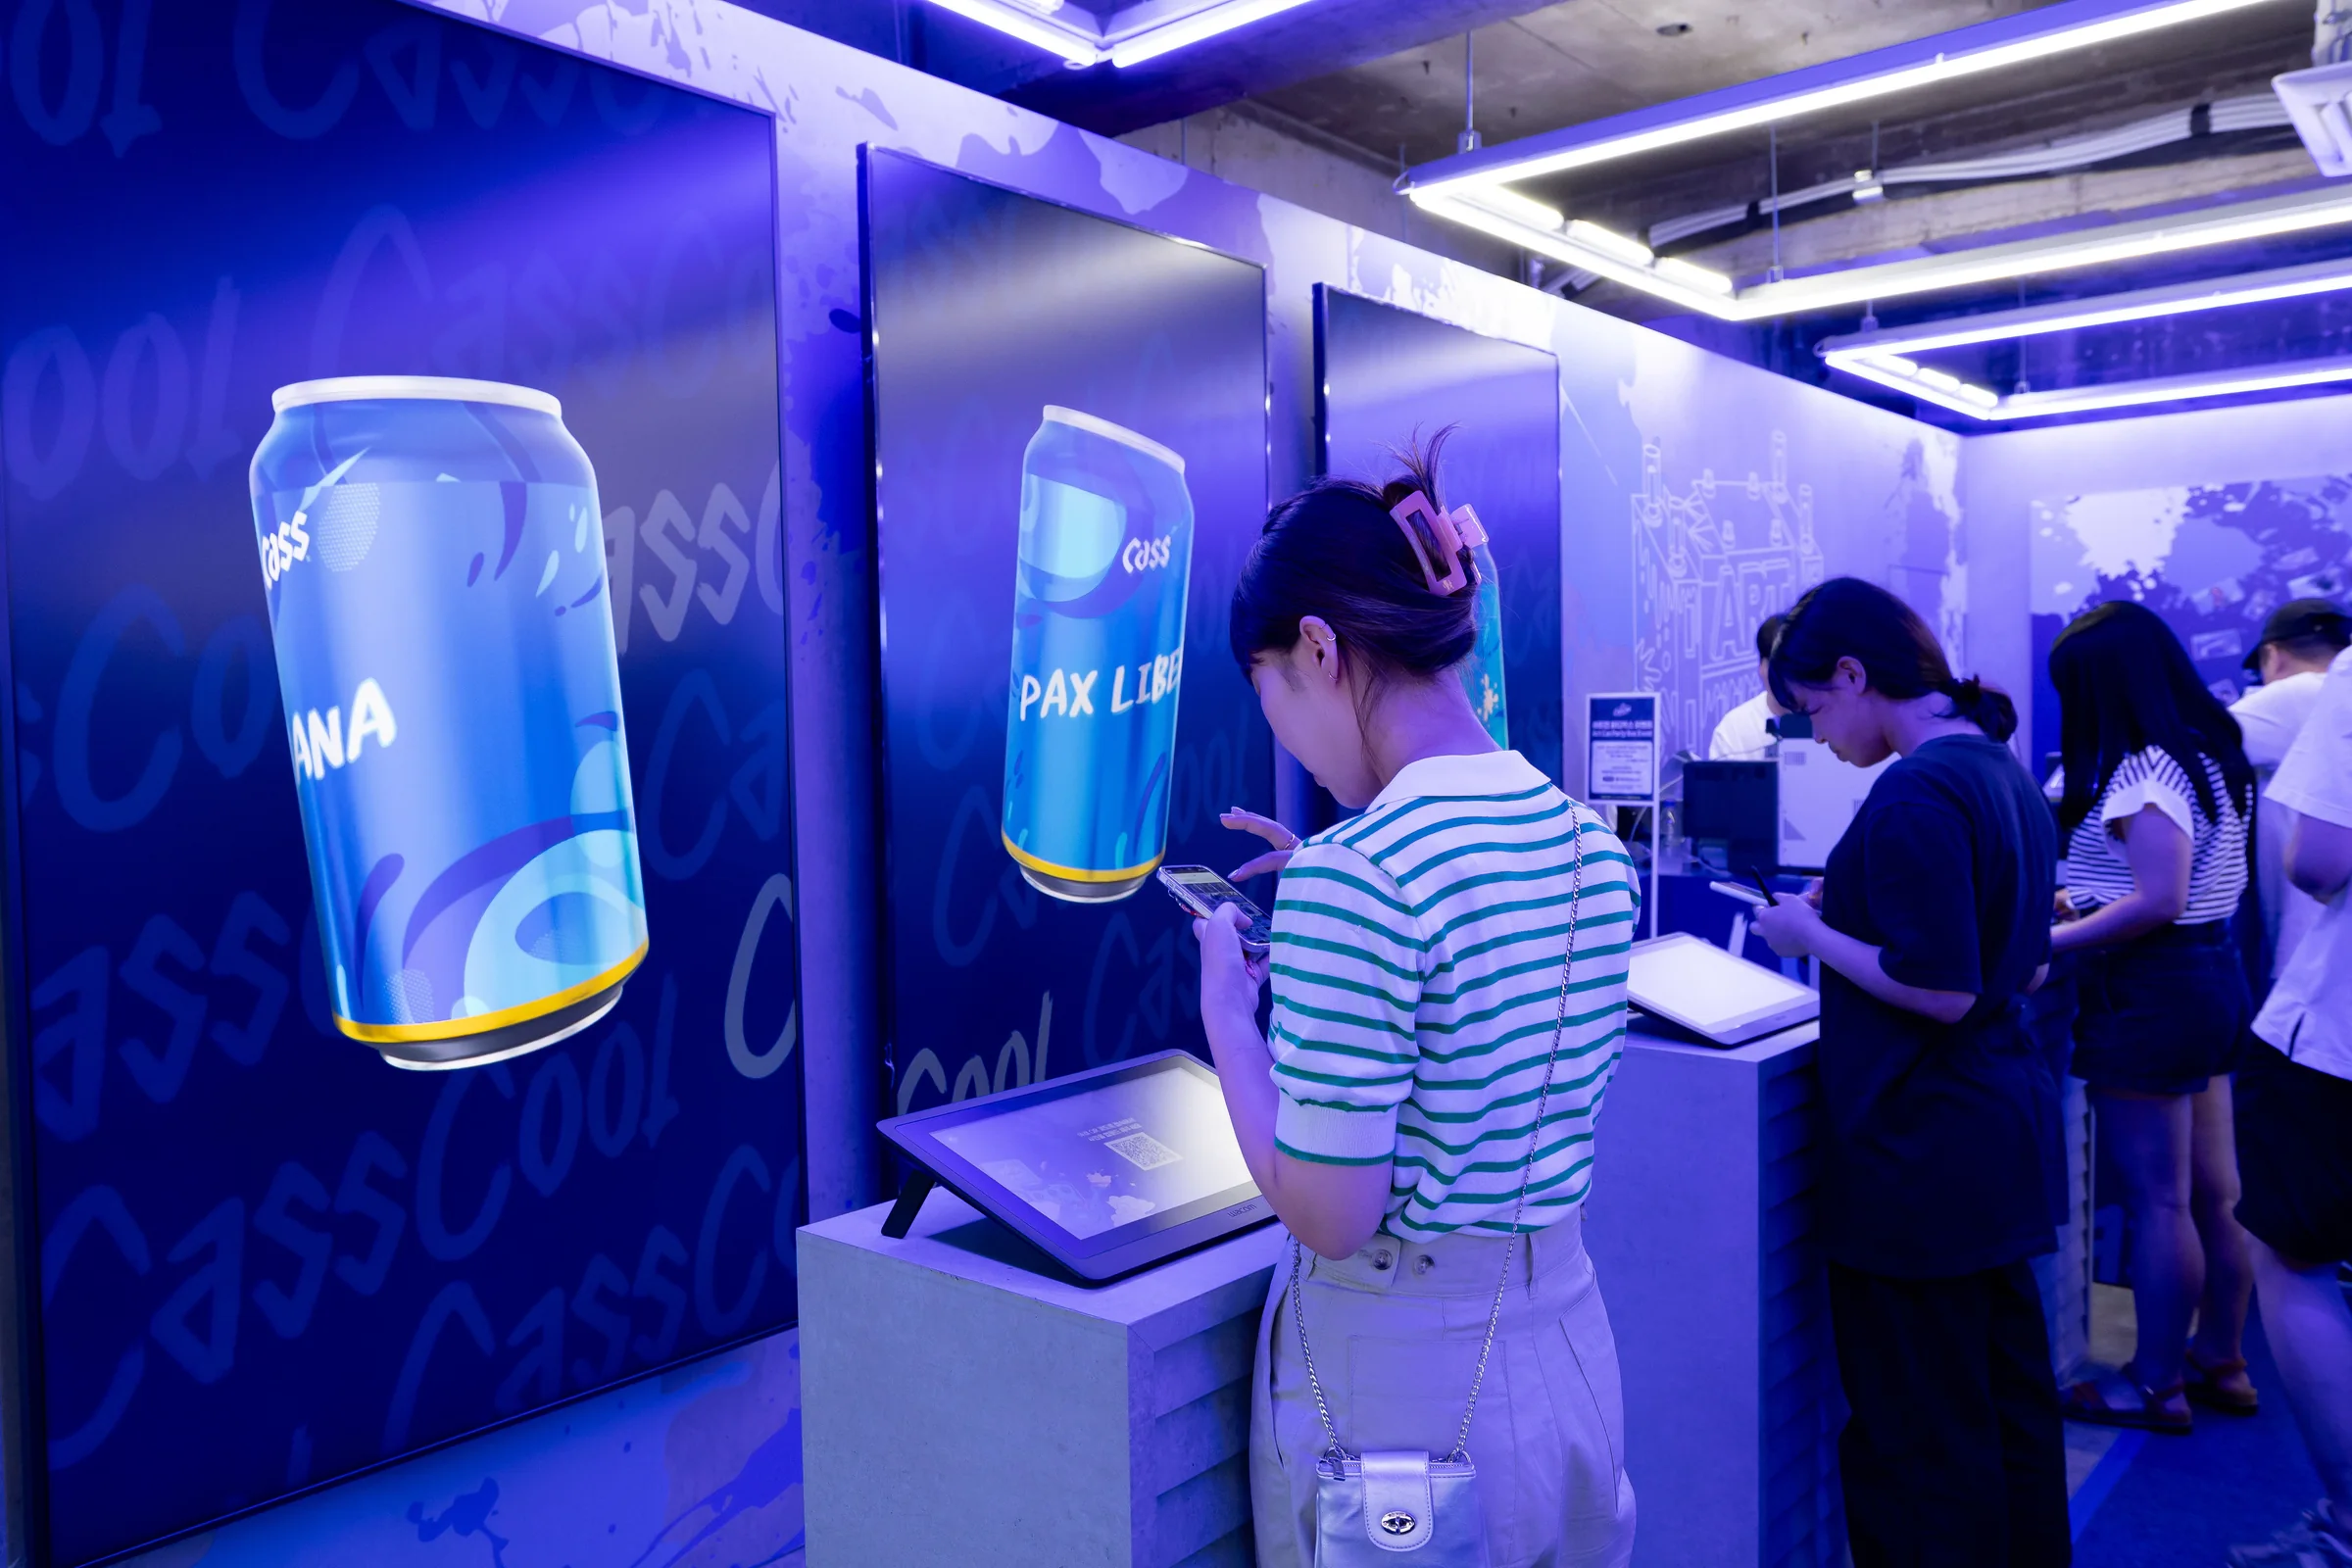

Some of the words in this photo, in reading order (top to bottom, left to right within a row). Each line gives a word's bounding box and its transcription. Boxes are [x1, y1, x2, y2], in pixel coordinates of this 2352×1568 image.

[1121, 534, 1172, 574] Cass
[1019, 667, 1099, 722] PAX
[292, 676, 397, 781] ANA
[1226, 1203, 1257, 1218] wacom
